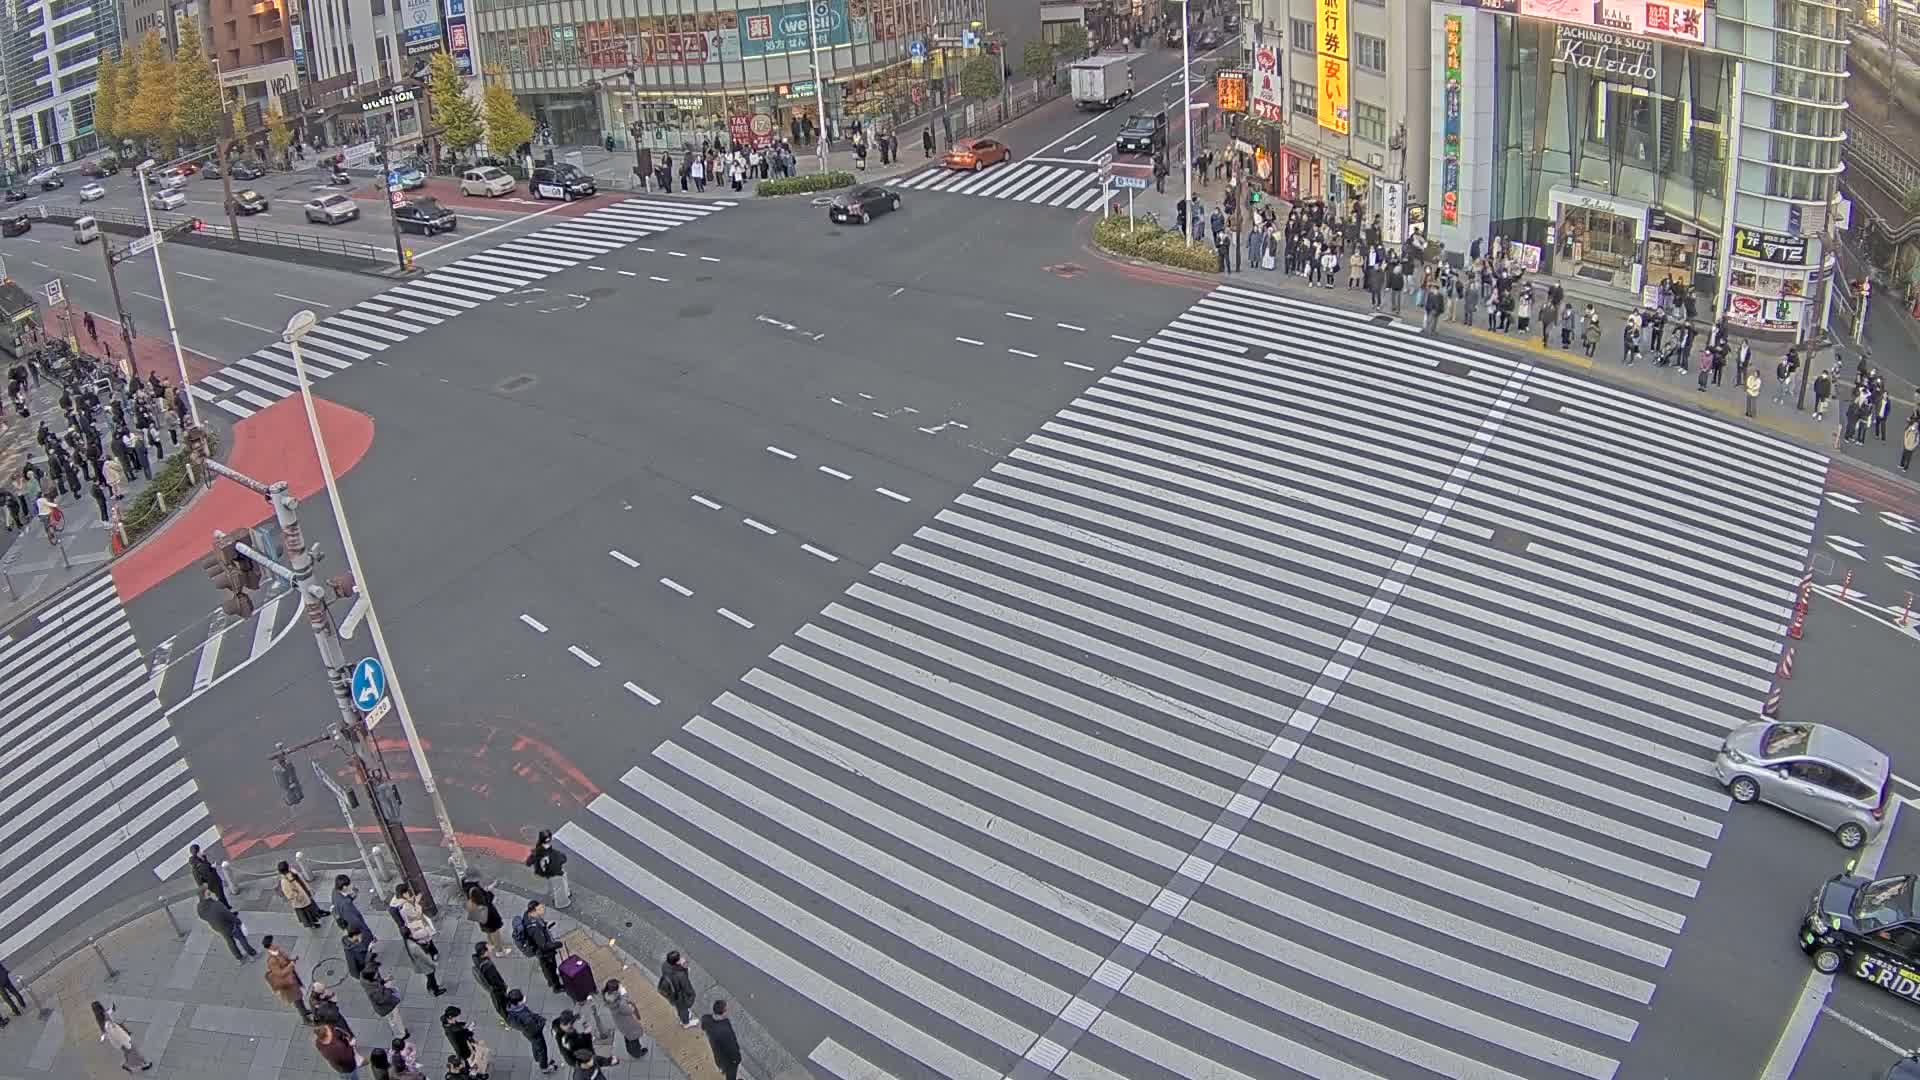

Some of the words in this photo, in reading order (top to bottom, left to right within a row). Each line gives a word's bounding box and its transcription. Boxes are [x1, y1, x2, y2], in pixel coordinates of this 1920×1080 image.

[1557, 26, 1613, 44] PACHINKO
[1625, 38, 1653, 51] SLOT
[1550, 39, 1656, 79] Kaleido
[732, 117, 747, 125] TAX
